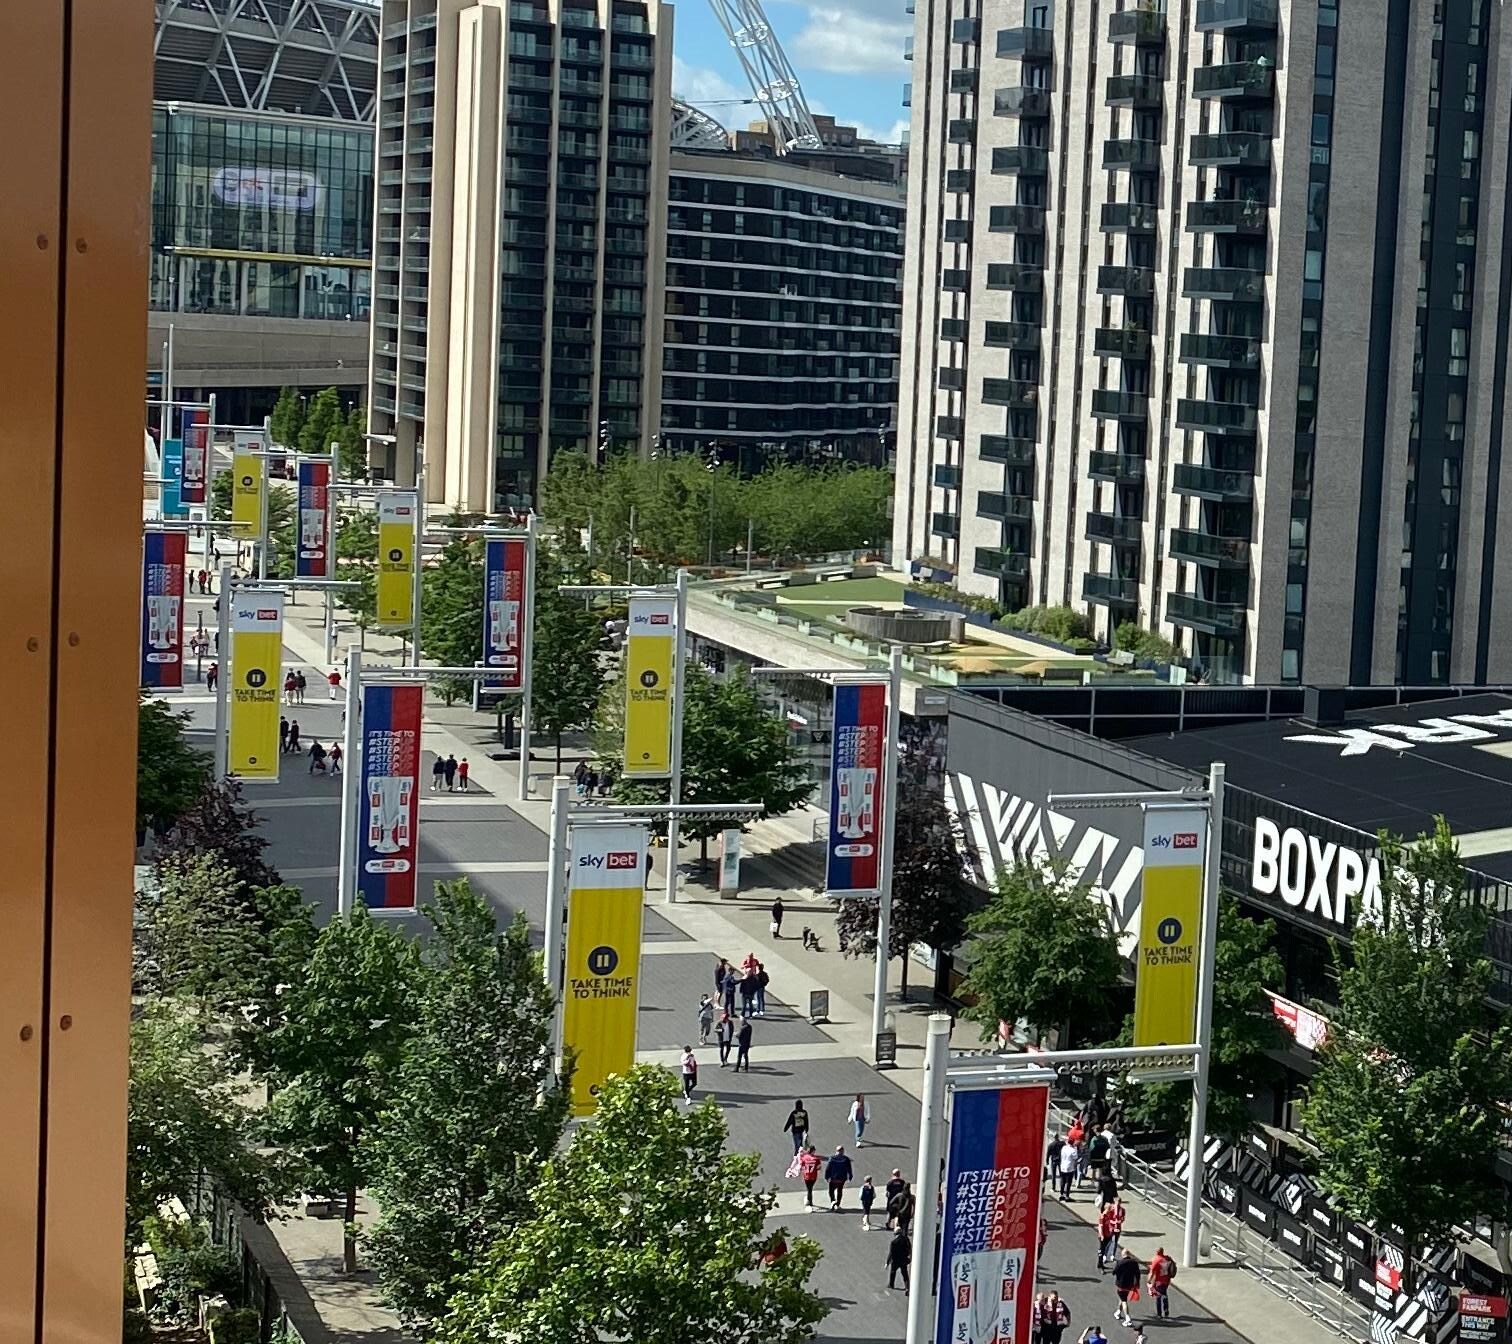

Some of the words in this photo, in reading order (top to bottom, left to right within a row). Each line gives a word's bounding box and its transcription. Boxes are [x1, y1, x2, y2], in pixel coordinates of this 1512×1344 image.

[239, 610, 255, 619] sky
[634, 616, 649, 624] sky
[1152, 835, 1171, 848] sky
[1175, 835, 1196, 846] bet
[579, 854, 604, 869] sky
[609, 854, 635, 866] bet
[1144, 947, 1167, 956] TAKE
[1170, 946, 1192, 955] TIME
[1146, 956, 1158, 965] TO
[1162, 954, 1191, 964] THINK
[571, 979, 601, 988] TAKE
[604, 977, 632, 987] TIME
[573, 989, 589, 998] TO
[592, 988, 630, 998] THINK
[957, 1170, 979, 1184] IT'S
[981, 1167, 1011, 1181] TIME
[1013, 1166, 1030, 1178] TO
[1003, 1258, 1014, 1276] sky
[959, 1285, 969, 1307] bet
[1003, 1280, 1013, 1300] bet
[956, 1322, 968, 1342] sky
[1000, 1318, 1010, 1336] sky
